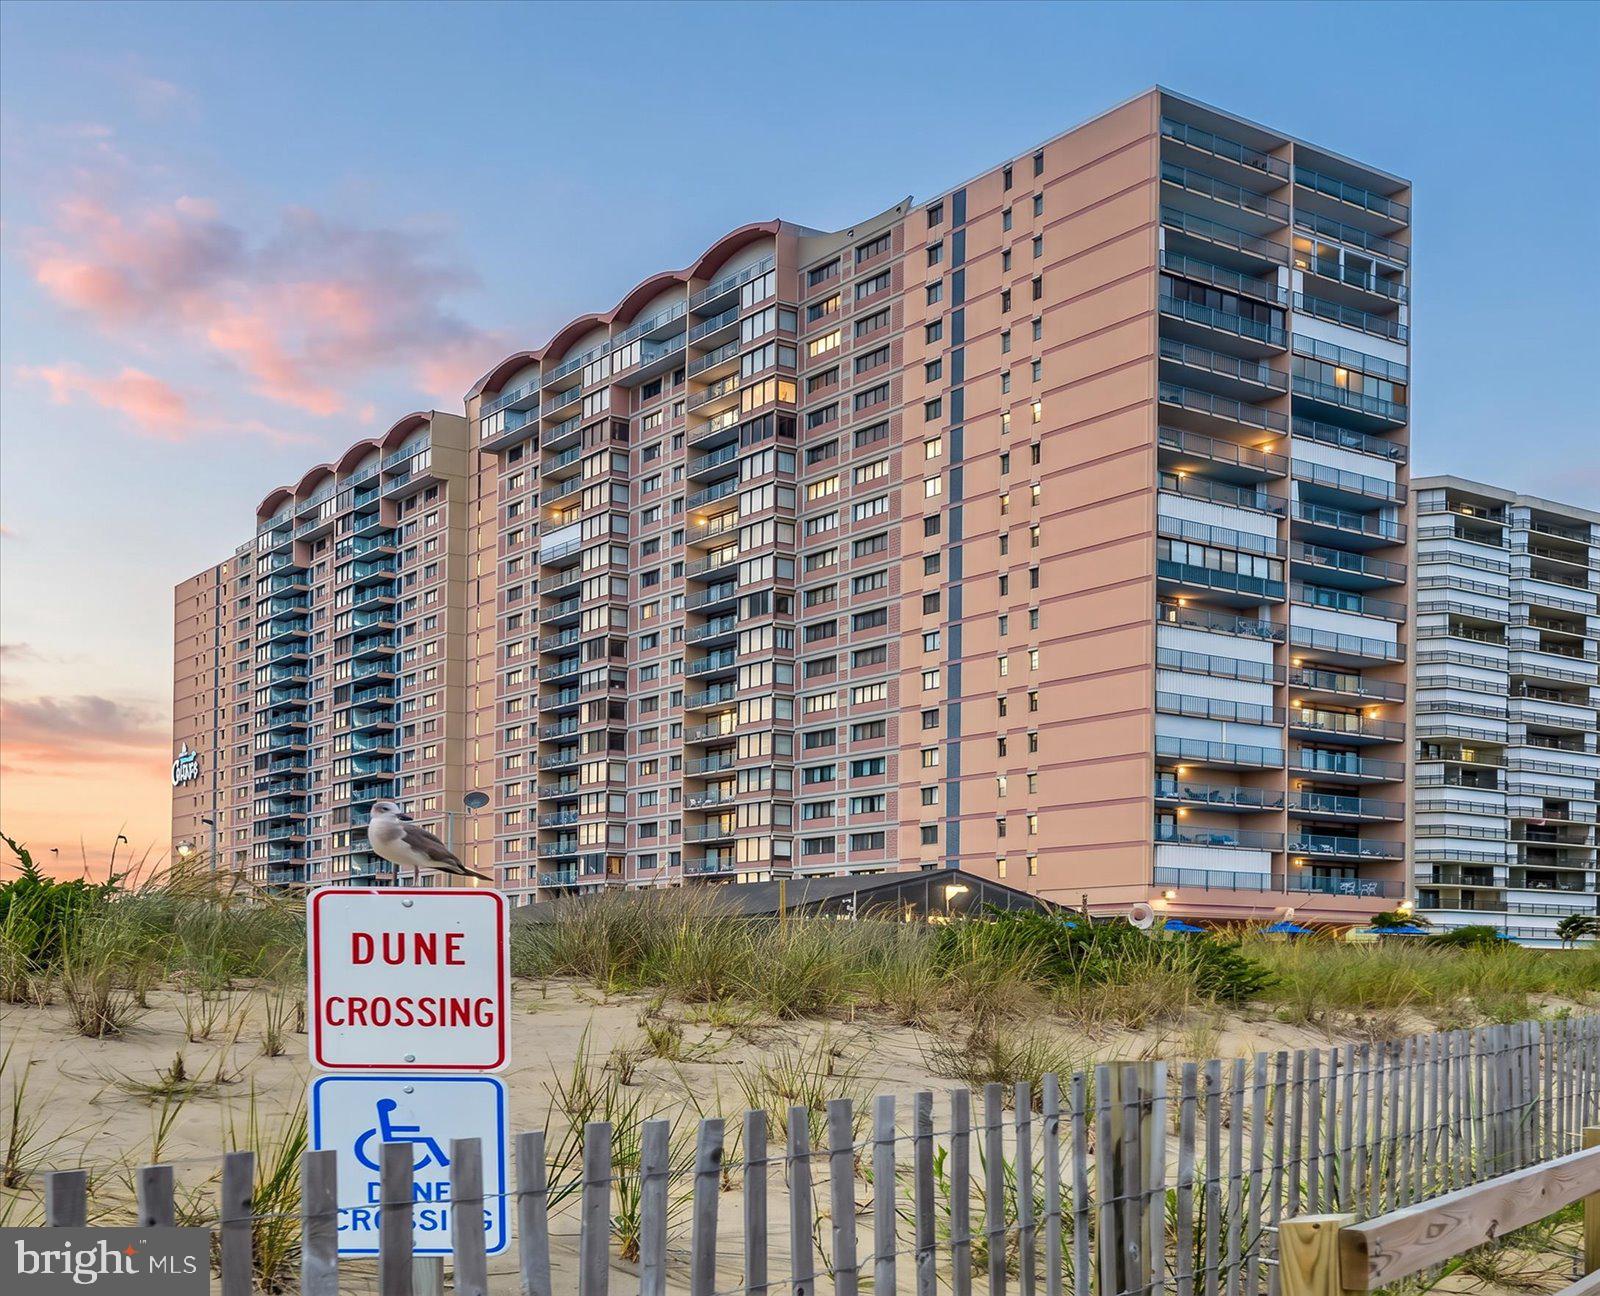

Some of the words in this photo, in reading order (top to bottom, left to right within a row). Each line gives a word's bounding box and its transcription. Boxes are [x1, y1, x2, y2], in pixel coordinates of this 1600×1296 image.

[352, 932, 466, 966] DUNE
[325, 996, 494, 1028] CROSSING
[368, 1181, 452, 1204] DNE
